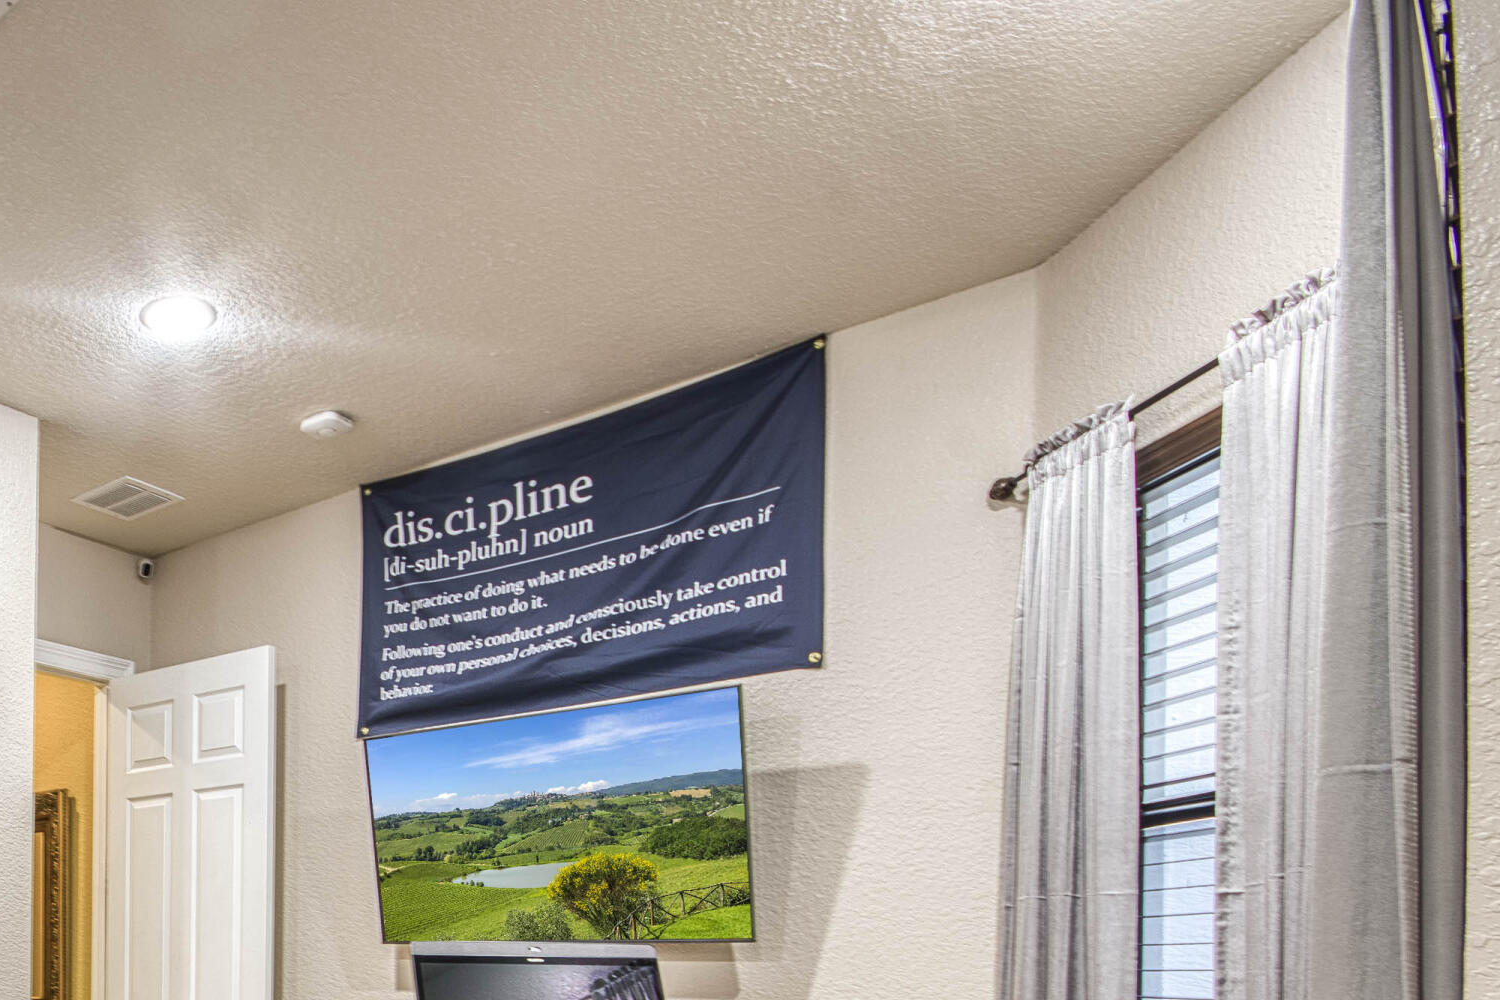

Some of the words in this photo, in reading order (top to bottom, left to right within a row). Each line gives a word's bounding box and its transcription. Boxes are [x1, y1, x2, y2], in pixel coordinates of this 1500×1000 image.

[383, 475, 594, 549] dis.ci.pline
[384, 528, 528, 583] [di-suh-pluhn]
[534, 518, 594, 548] noun
[384, 600, 411, 615] The
[411, 591, 463, 615] practice
[464, 584, 483, 601] of
[481, 580, 525, 599] doing
[527, 570, 566, 589] what
[568, 555, 617, 579] needs
[619, 552, 637, 566] to
[639, 544, 660, 560] be
[659, 527, 705, 550] done
[707, 516, 754, 538] even
[757, 503, 775, 525] if
[380, 665, 397, 681] of
[395, 666, 427, 683] your
[426, 662, 457, 677] own
[456, 647, 520, 675] personal
[518, 635, 578, 659] choices,
[580, 617, 667, 645] decisions,
[668, 599, 741, 626] actions,
[743, 584, 785, 609] and
[381, 642, 447, 662] Following
[446, 634, 484, 654] one's
[483, 625, 545, 648] conduct
[544, 614, 576, 635] and
[575, 589, 674, 625] consciously
[675, 581, 715, 602] take
[716, 558, 788, 590] control
[383, 622, 409, 639] you
[409, 616, 428, 632] do
[428, 613, 451, 629] not
[451, 607, 489, 624] want
[490, 605, 508, 618] to
[507, 598, 529, 614] do
[530, 595, 549, 610] it.
[379, 682, 434, 701] behavior.
